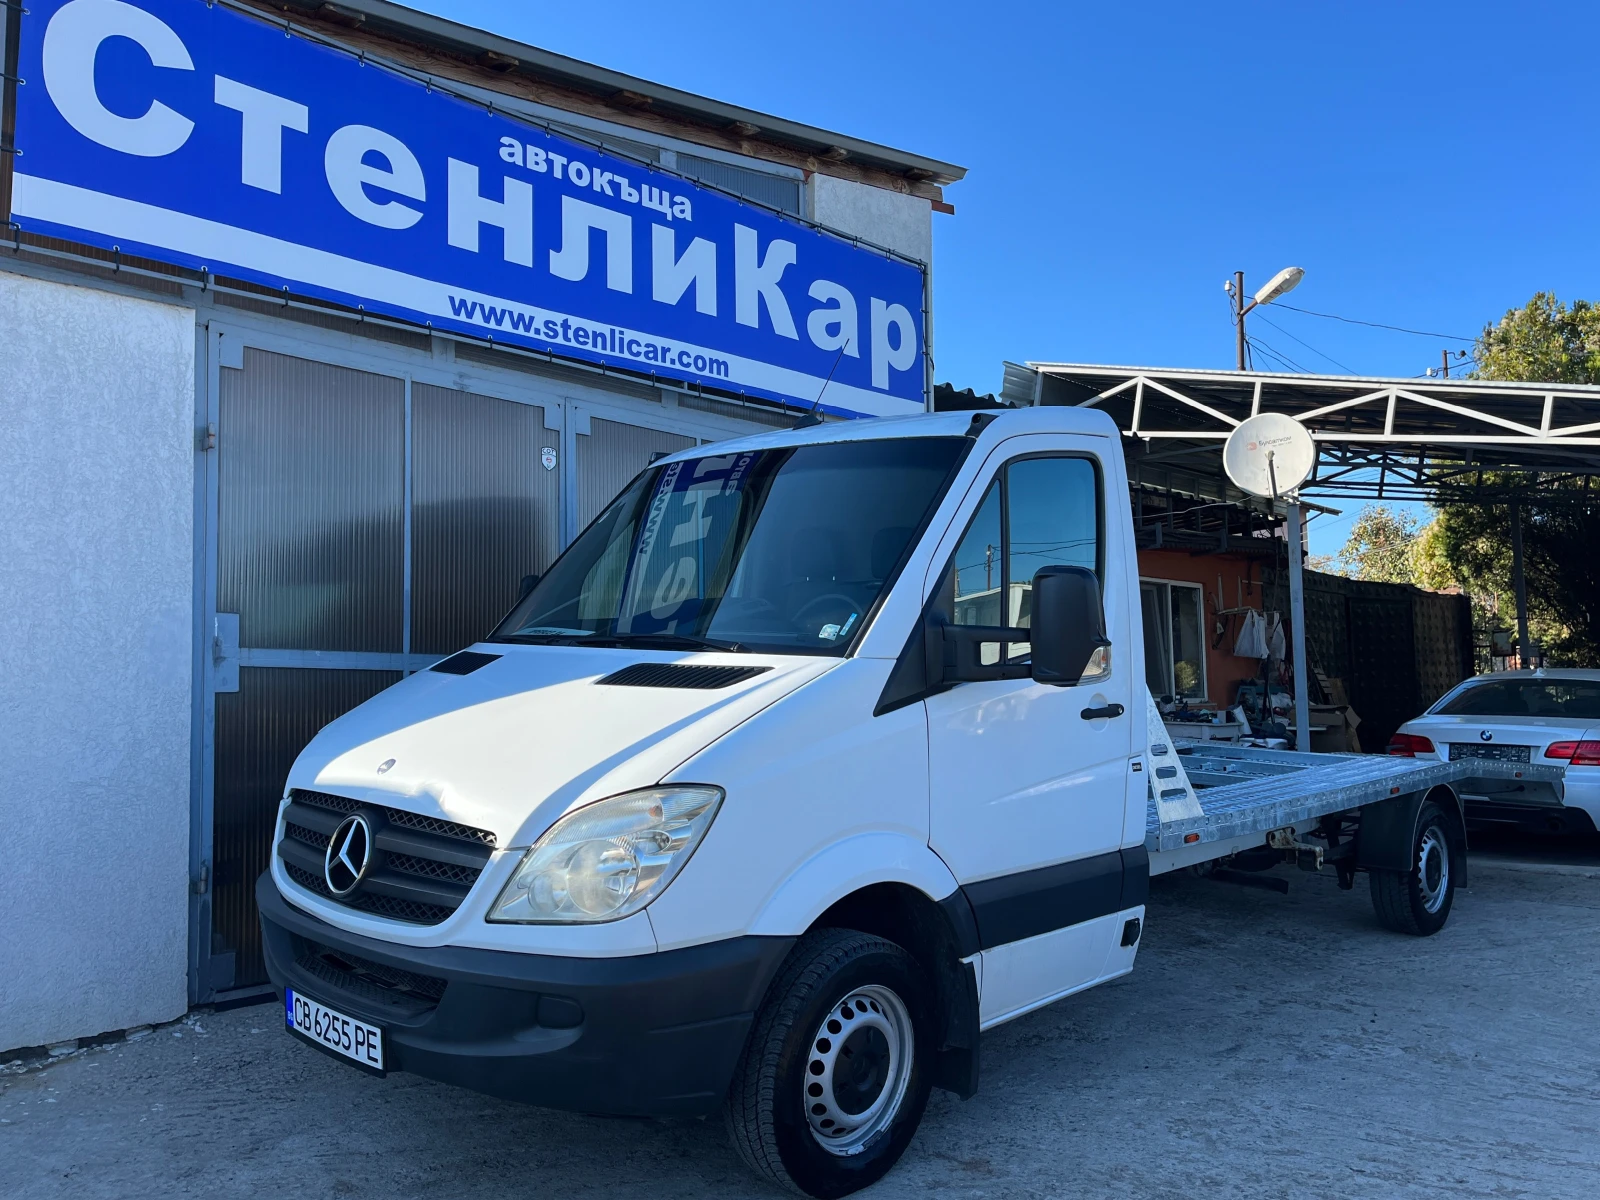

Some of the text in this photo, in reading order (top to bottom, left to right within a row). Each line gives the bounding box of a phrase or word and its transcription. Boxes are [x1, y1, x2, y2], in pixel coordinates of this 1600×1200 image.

[42, 0, 917, 390] СтенлиКар
[499, 136, 692, 222] автокъща
[448, 295, 729, 378] www.stenlicar.com
[314, 1008, 352, 1051] 6255
